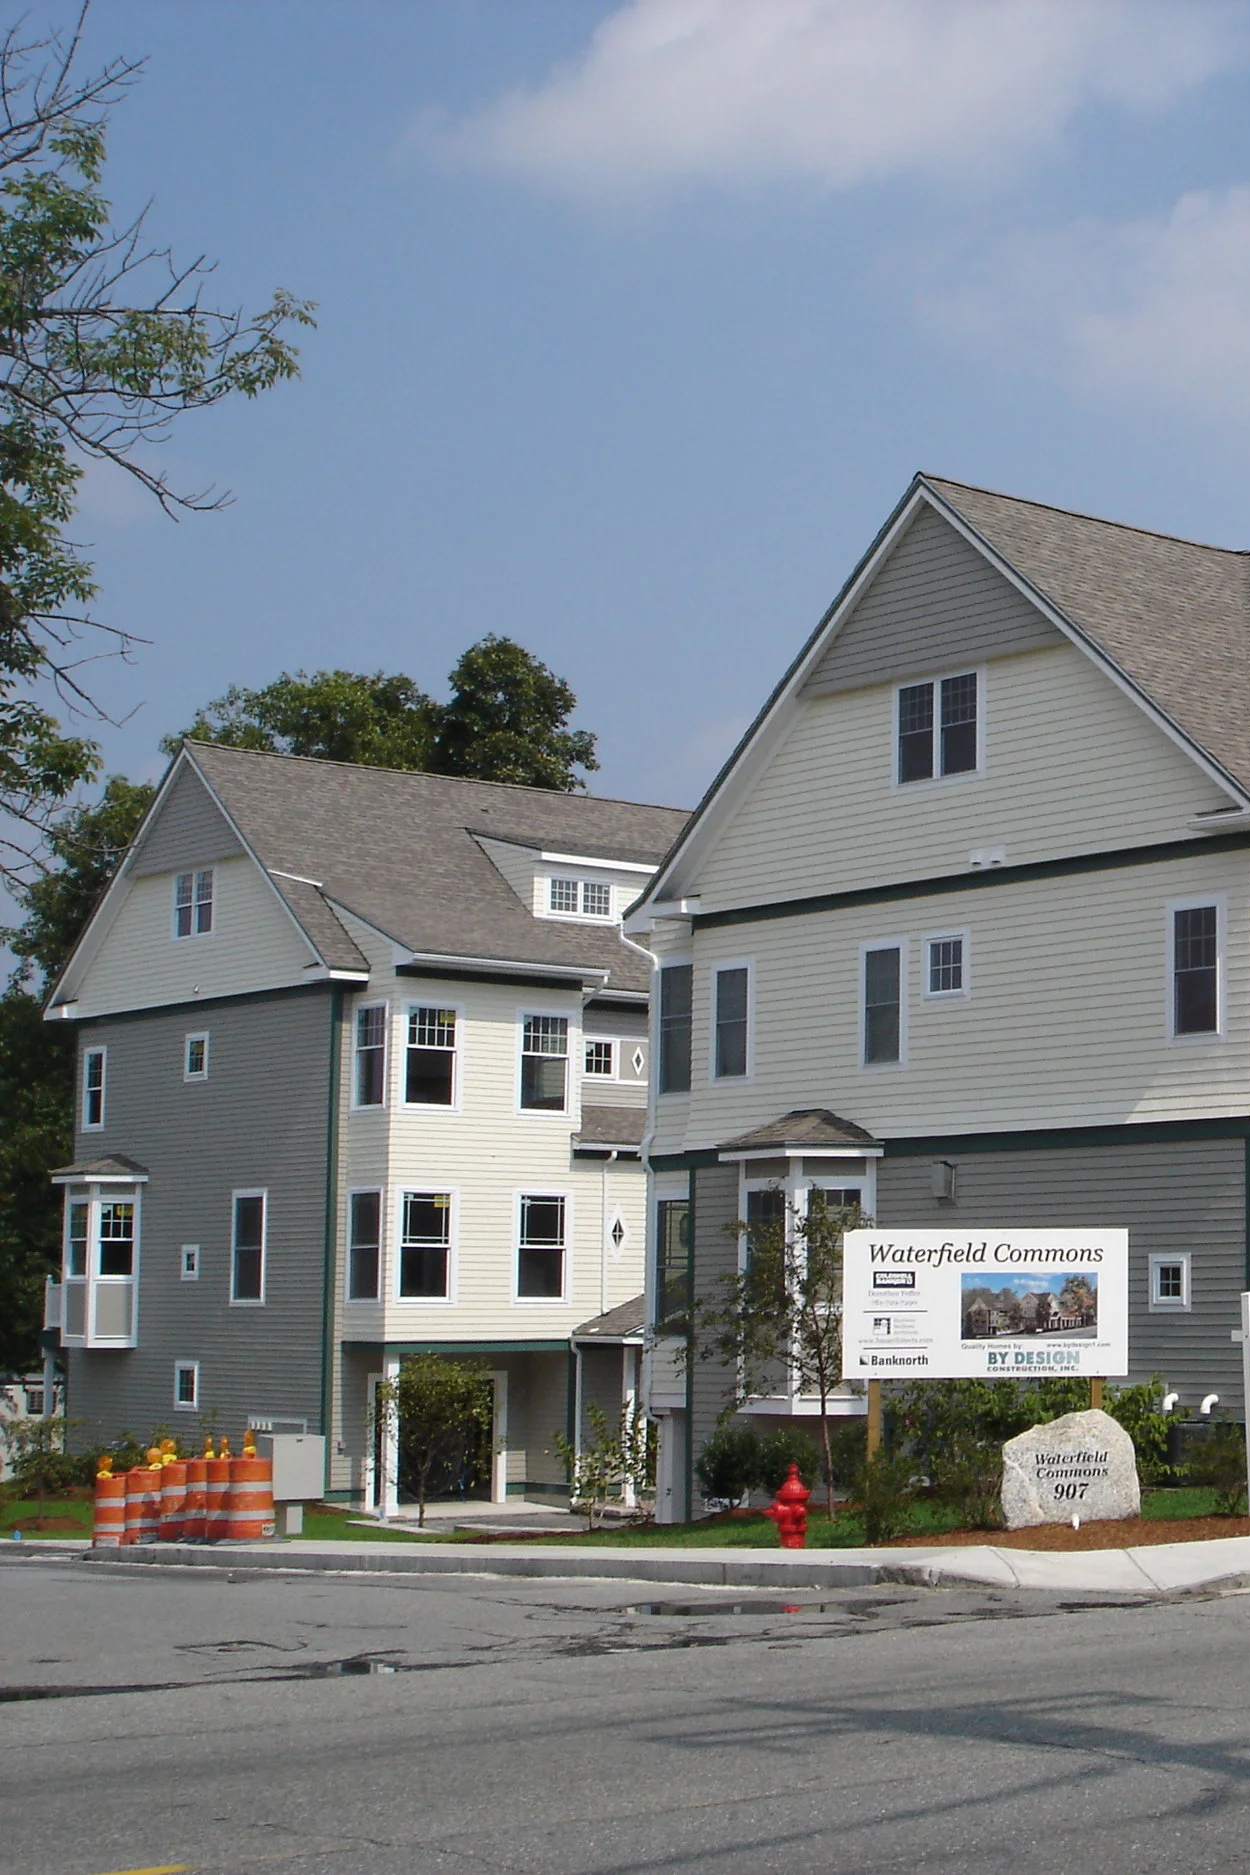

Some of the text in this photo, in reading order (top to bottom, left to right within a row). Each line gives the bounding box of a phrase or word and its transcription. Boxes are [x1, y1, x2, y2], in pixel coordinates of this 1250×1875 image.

[868, 1242, 1104, 1267] Waterfield Commons
[871, 1355, 928, 1366] Banknorth
[988, 1351, 1080, 1365] BY DESIGN
[1035, 1451, 1109, 1466] Waterfield
[1036, 1467, 1109, 1480] Commons
[1053, 1483, 1089, 1500] 907
